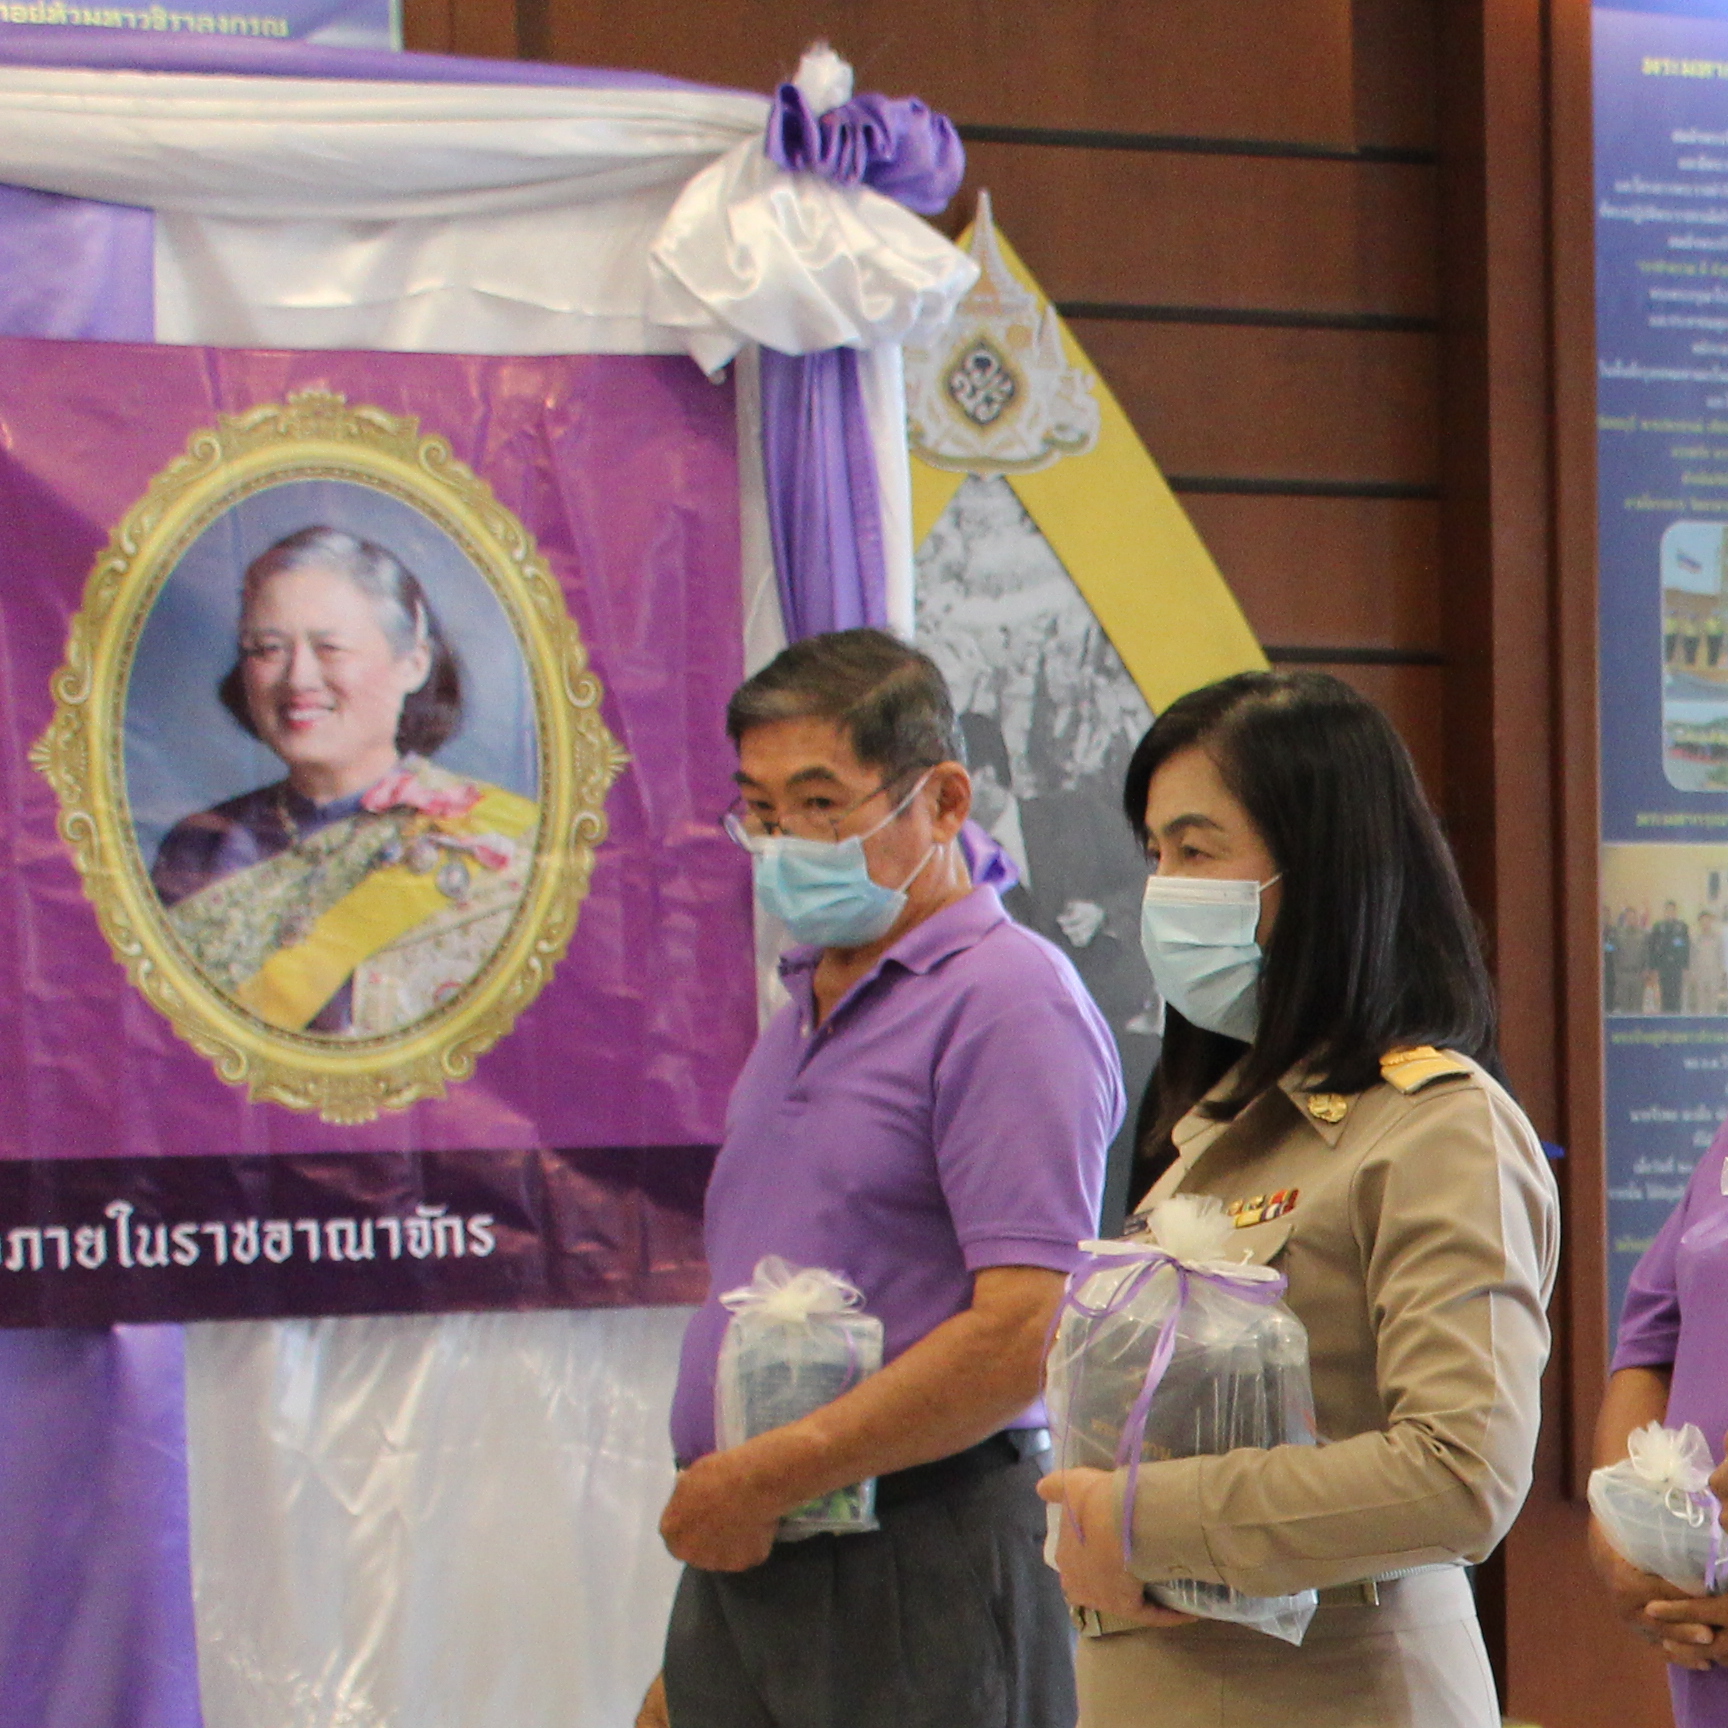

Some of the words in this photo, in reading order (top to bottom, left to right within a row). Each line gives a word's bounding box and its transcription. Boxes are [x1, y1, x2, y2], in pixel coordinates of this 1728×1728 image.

[0, 1199, 497, 1272] ภายในราชอาณาจักร
